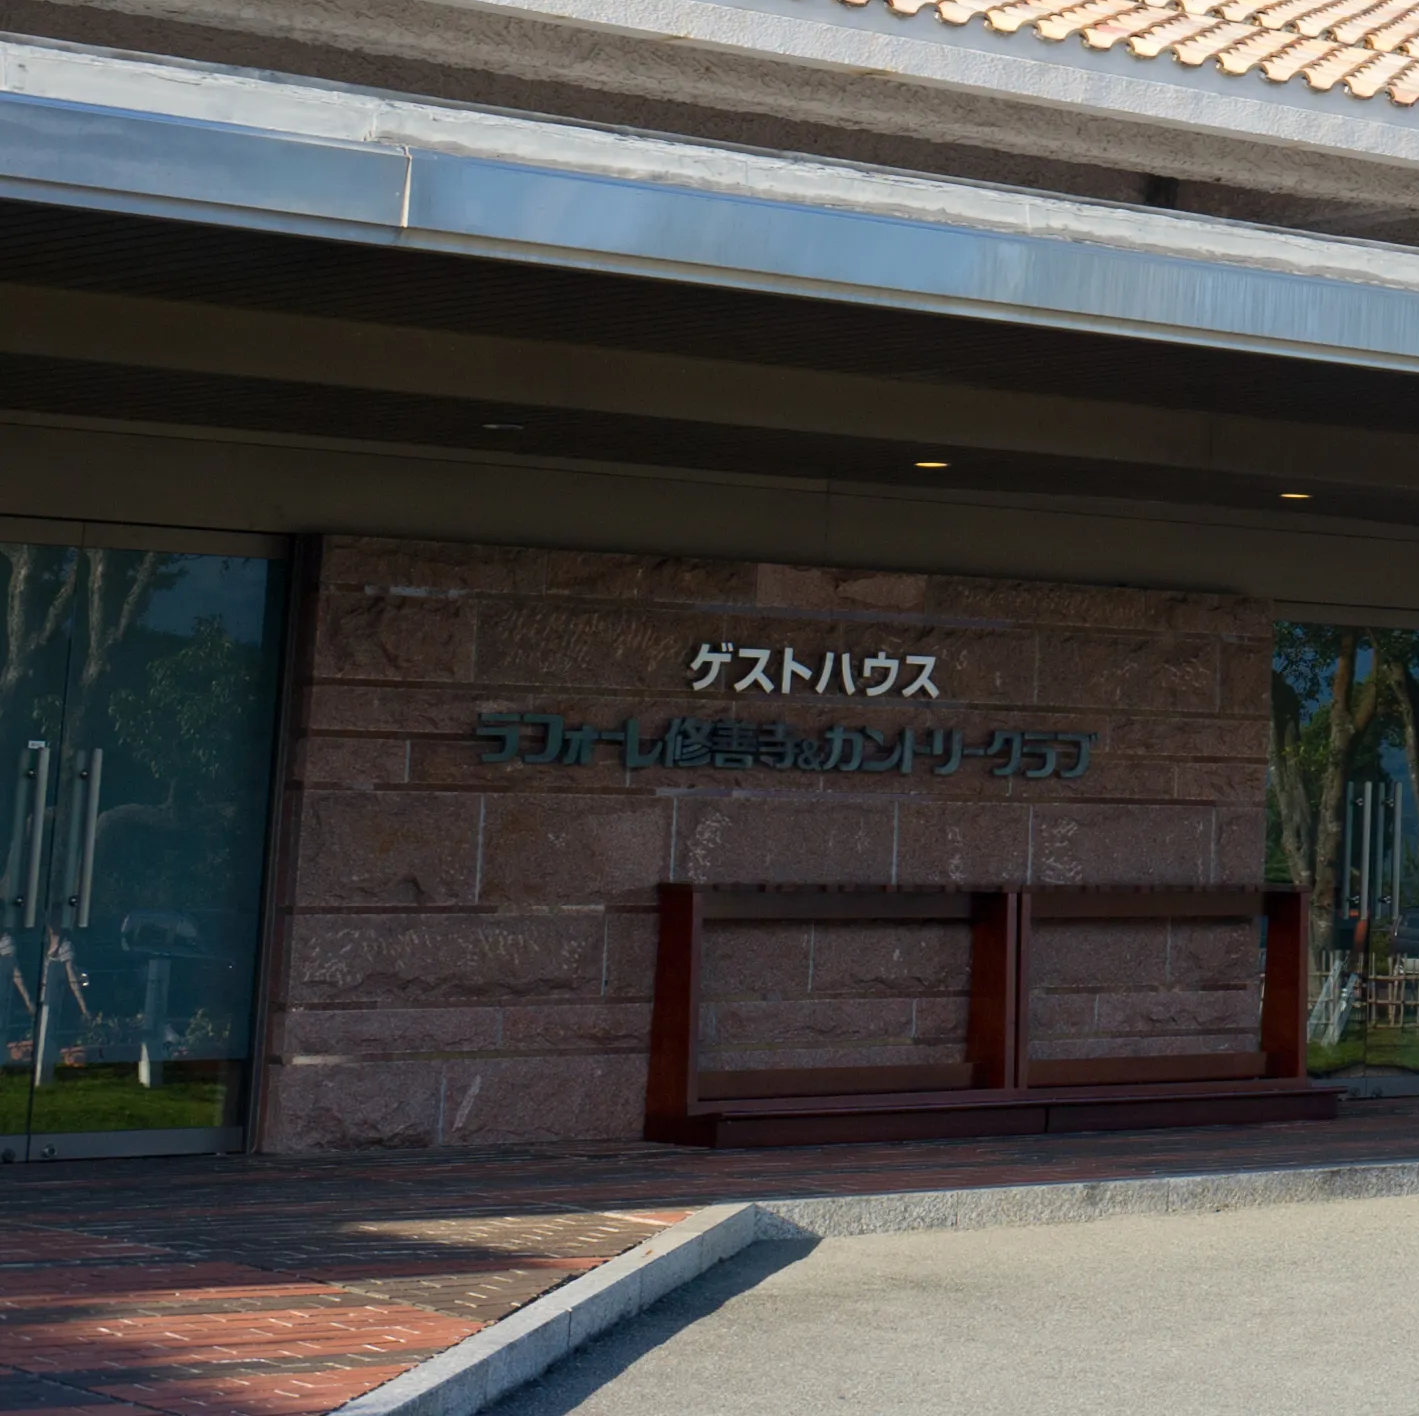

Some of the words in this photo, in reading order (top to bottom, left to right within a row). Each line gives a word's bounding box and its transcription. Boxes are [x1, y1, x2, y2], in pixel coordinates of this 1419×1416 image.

[689, 641, 940, 699] ゲストハウス
[475, 712, 1099, 779] ラフォーレ修善寺&カントリークラブ
